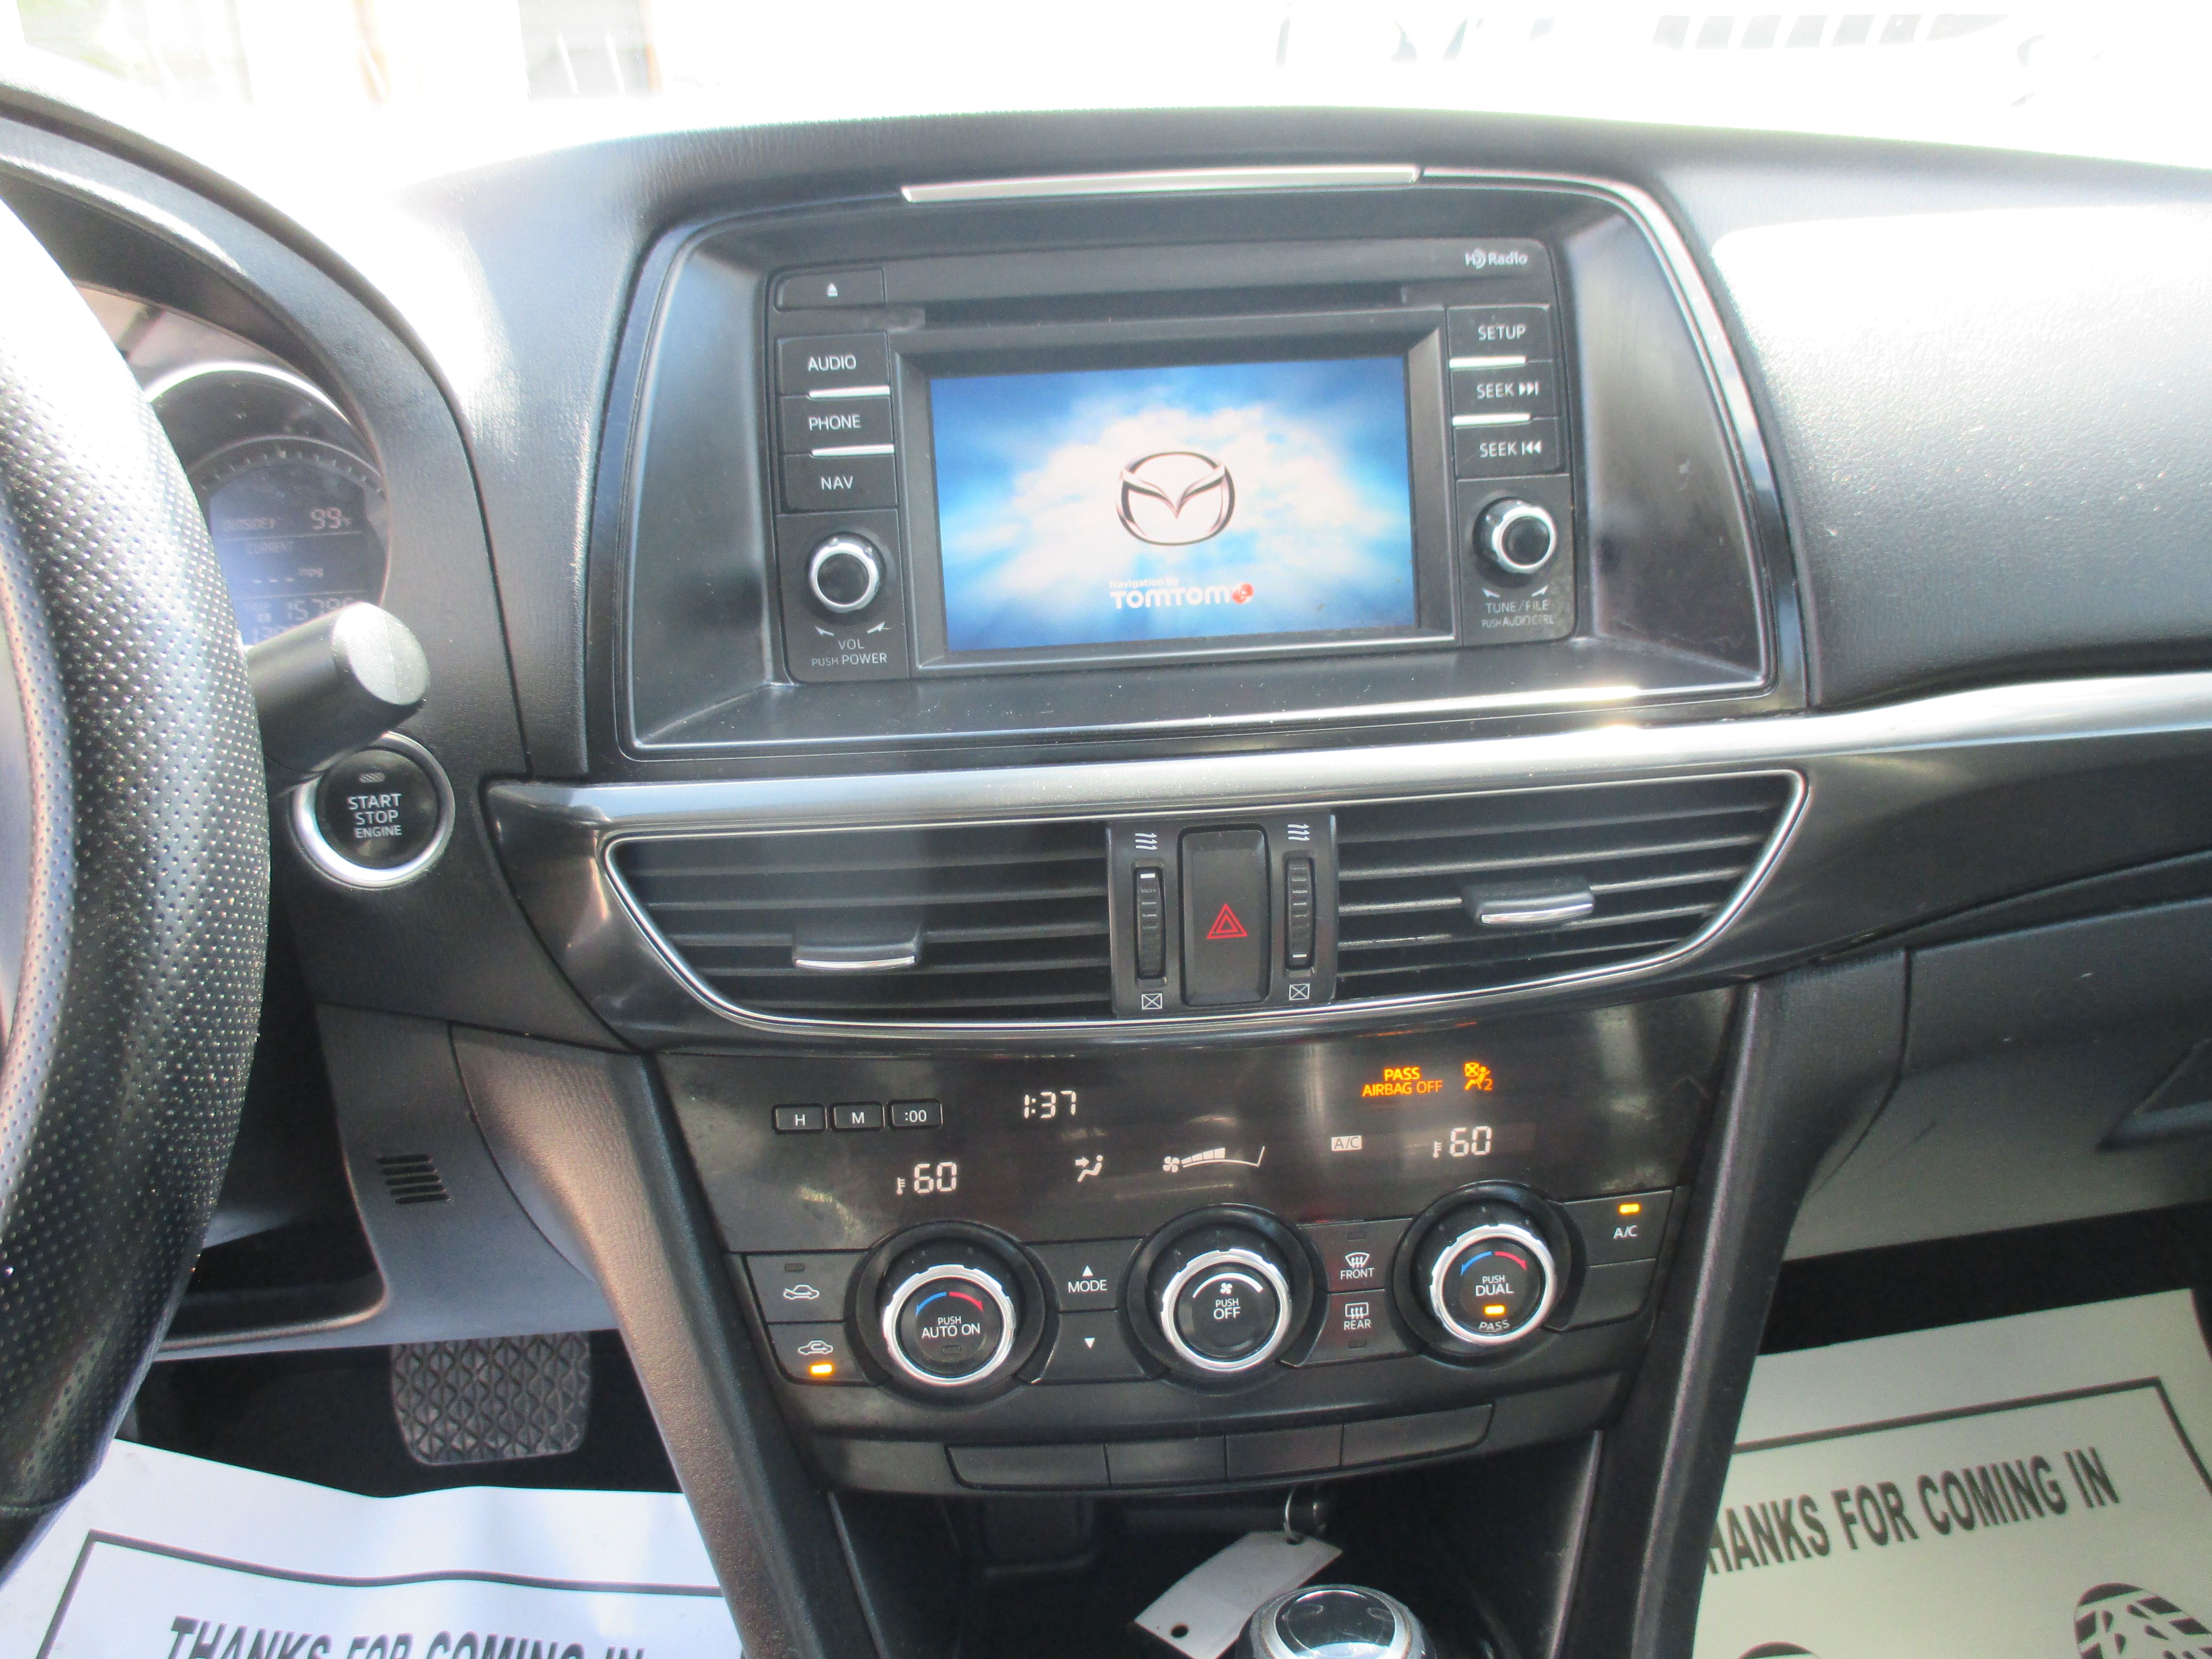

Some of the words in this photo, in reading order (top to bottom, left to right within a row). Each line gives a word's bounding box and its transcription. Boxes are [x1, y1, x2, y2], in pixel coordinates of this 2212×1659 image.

[1488, 252, 1528, 266] Radio
[1478, 325, 1527, 341] SETUP
[807, 355, 857, 372] AUDIO
[1477, 383, 1514, 399] SEEK
[809, 414, 861, 430] PHONE
[1479, 442, 1517, 458] SEEK
[821, 476, 854, 490] NAV
[1110, 577, 1164, 589] Navigation
[1166, 577, 1179, 587] by
[1486, 599, 1549, 613] TUNE/FILE
[838, 639, 864, 650] VOL
[811, 656, 839, 667] PUSH
[841, 653, 887, 665] POWER
[347, 793, 402, 810] START
[354, 809, 399, 825] STOP
[354, 825, 402, 838] ENGINE
[1384, 1067, 1421, 1082] PASS
[1362, 1081, 1413, 1097] AIRBAG
[1416, 1080, 1443, 1094] OFF
[1024, 1090, 1076, 1119] 1:37
[795, 1114, 805, 1126] H
[852, 1112, 865, 1124] M
[904, 1110, 927, 1123] :00
[1334, 1136, 1360, 1150] A/C
[1449, 1126, 1492, 1157] 60
[914, 1162, 957, 1193] 60
[1613, 1225, 1637, 1239] A/C
[1340, 1266, 1374, 1280] FRONT
[1482, 1275, 1505, 1285] PUSH
[1068, 1280, 1107, 1292] MODE
[1475, 1284, 1514, 1297] DUAL
[1215, 1298, 1239, 1308] PUSH
[938, 1316, 962, 1325] PUSH
[1214, 1306, 1241, 1321] OFF
[922, 1325, 958, 1339] AUTO
[961, 1322, 981, 1335] ON
[1344, 1319, 1372, 1331] REAR
[1479, 1320, 1510, 1332] PASS
[1704, 1493, 1830, 1575] HANKS
[1831, 1480, 1920, 1551] FOR
[1916, 1455, 2067, 1536] COMING
[2063, 1446, 2119, 1508] IN
